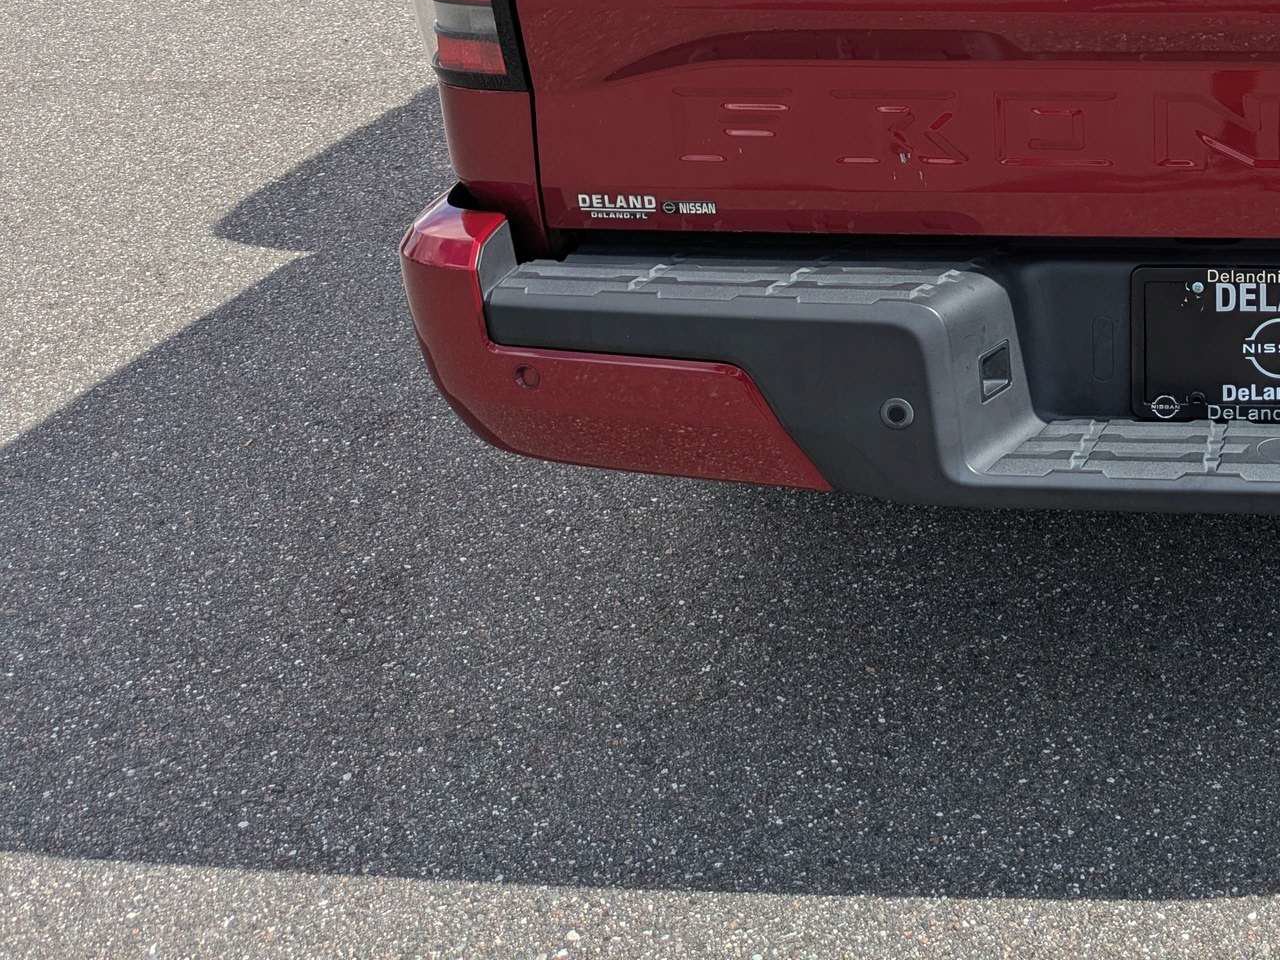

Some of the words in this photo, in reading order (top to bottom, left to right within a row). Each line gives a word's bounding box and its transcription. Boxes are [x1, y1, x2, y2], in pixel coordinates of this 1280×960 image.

[578, 193, 657, 209] DELAND
[678, 202, 717, 214] NISSAN
[636, 212, 648, 220] FL
